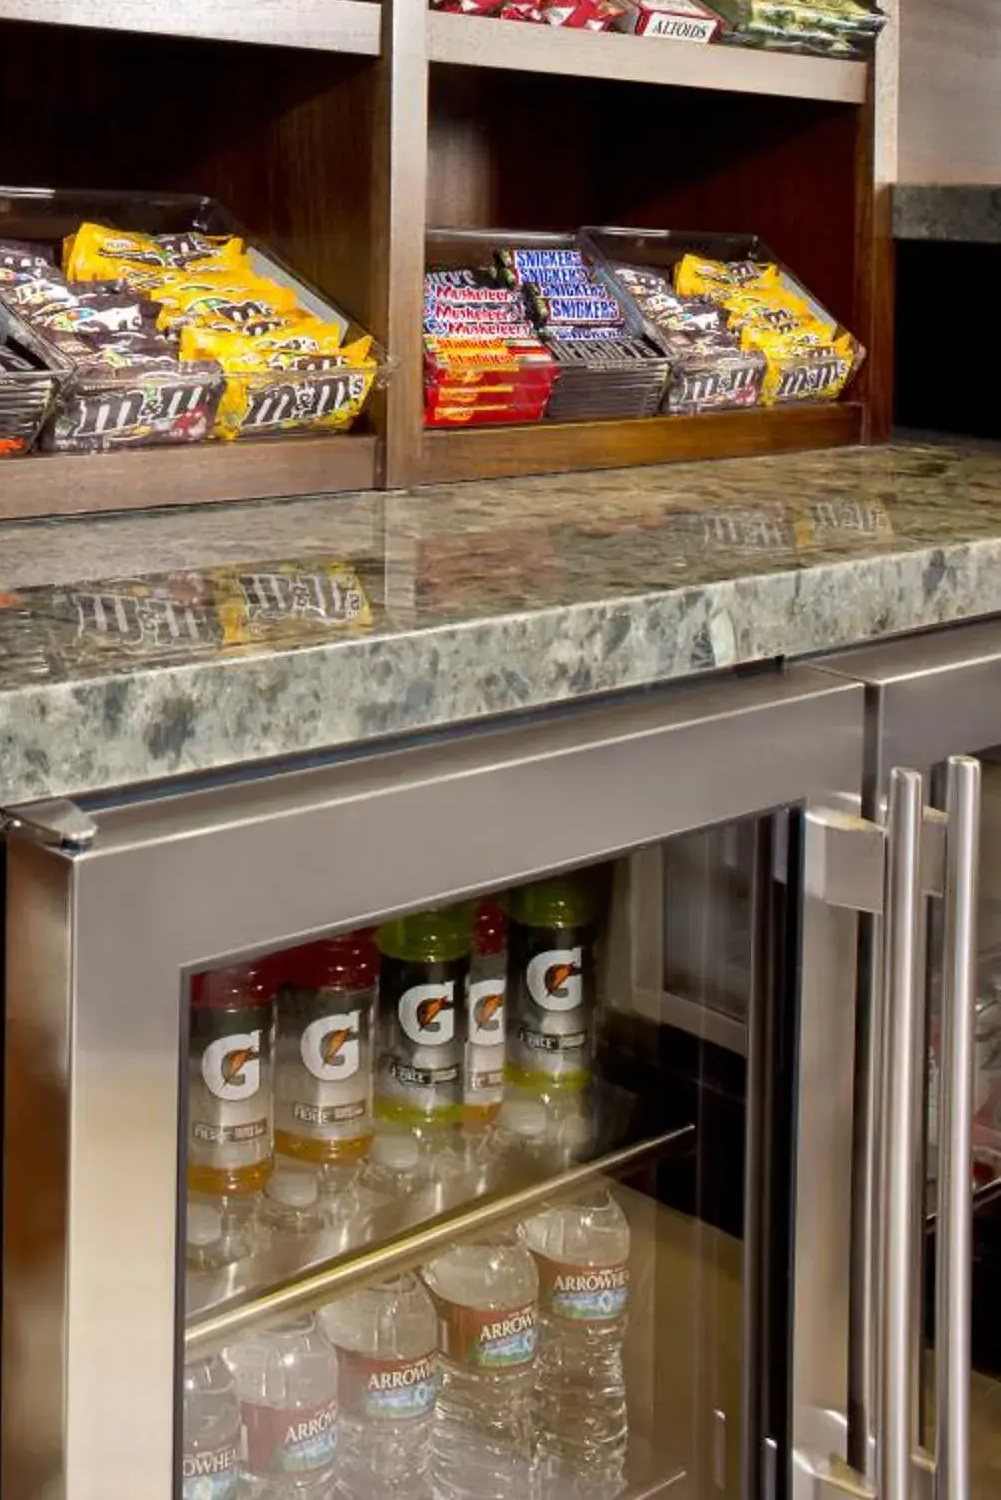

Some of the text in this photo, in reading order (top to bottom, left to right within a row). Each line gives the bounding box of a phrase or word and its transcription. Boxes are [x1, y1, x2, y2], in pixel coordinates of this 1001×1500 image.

[651, 18, 710, 40] ALTOIDS
[516, 250, 582, 268] SNICKERS
[552, 301, 618, 319] SNICKERS
[399, 979, 456, 1045] G
[526, 946, 584, 1012] G
[201, 1029, 263, 1100] G
[300, 1009, 362, 1081] G
